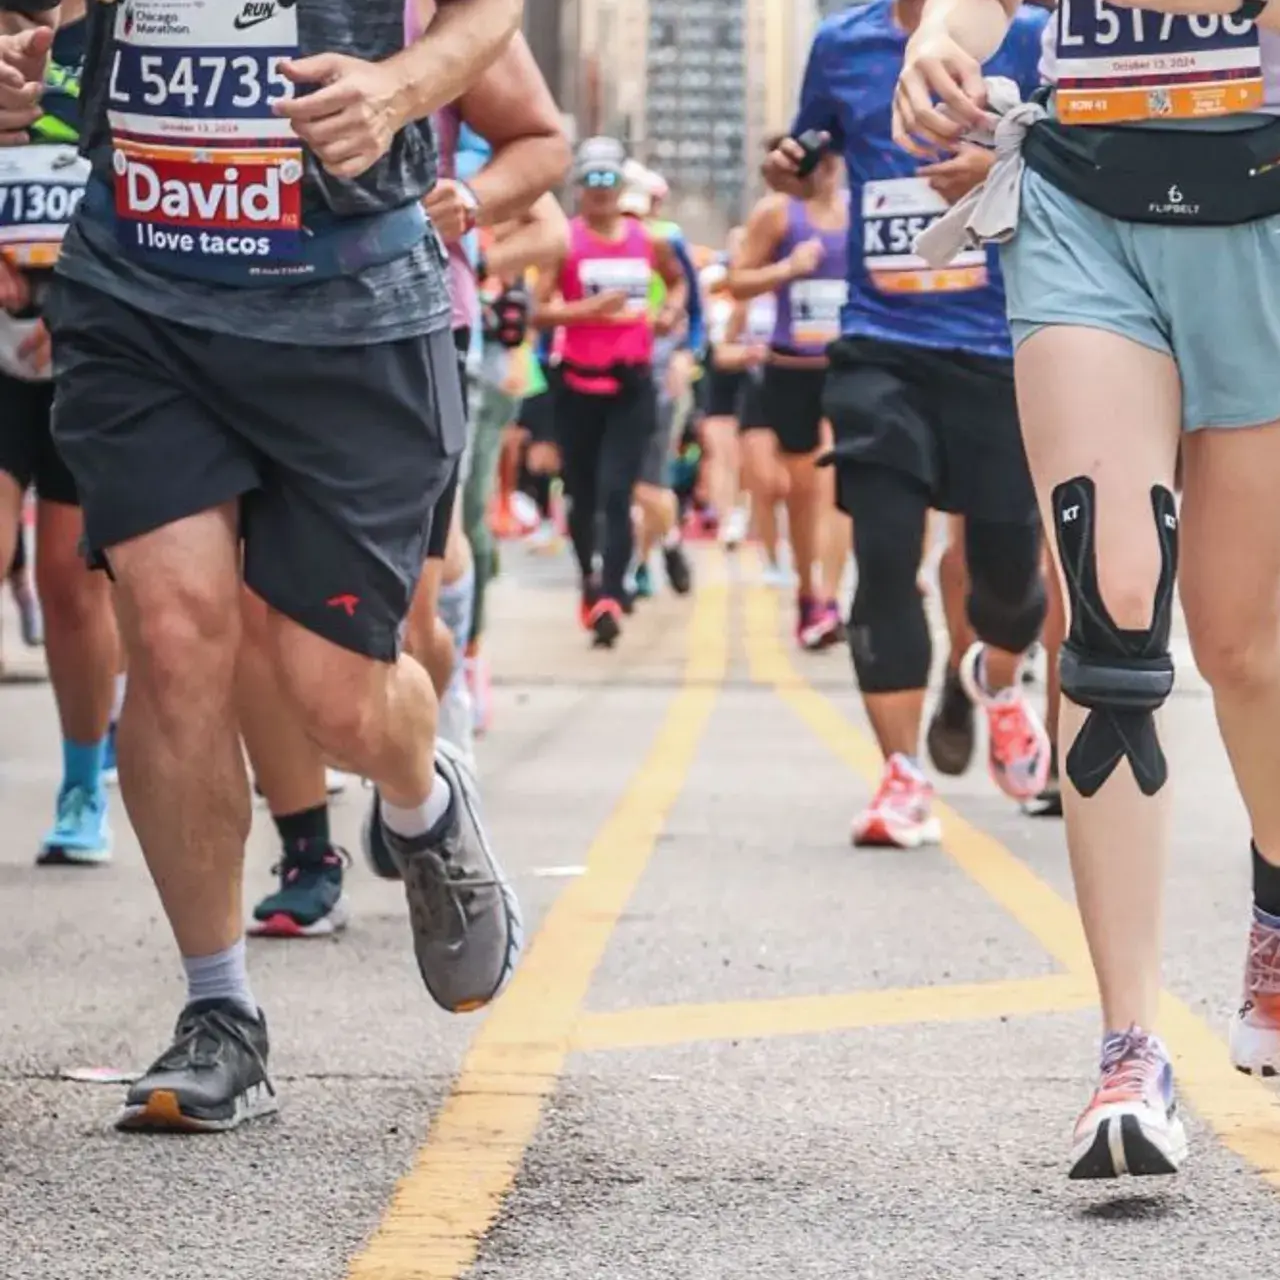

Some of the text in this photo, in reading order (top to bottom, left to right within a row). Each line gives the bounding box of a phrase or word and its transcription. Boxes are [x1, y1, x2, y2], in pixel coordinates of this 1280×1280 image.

[136, 10, 179, 25] Chicago
[242, 3, 276, 17] RUN
[136, 23, 190, 34] Marathon
[109, 49, 296, 108] L 54735
[127, 162, 280, 221] David
[147, 223, 195, 251] love
[200, 232, 270, 256] tacos
[1062, 505, 1080, 522] KT
